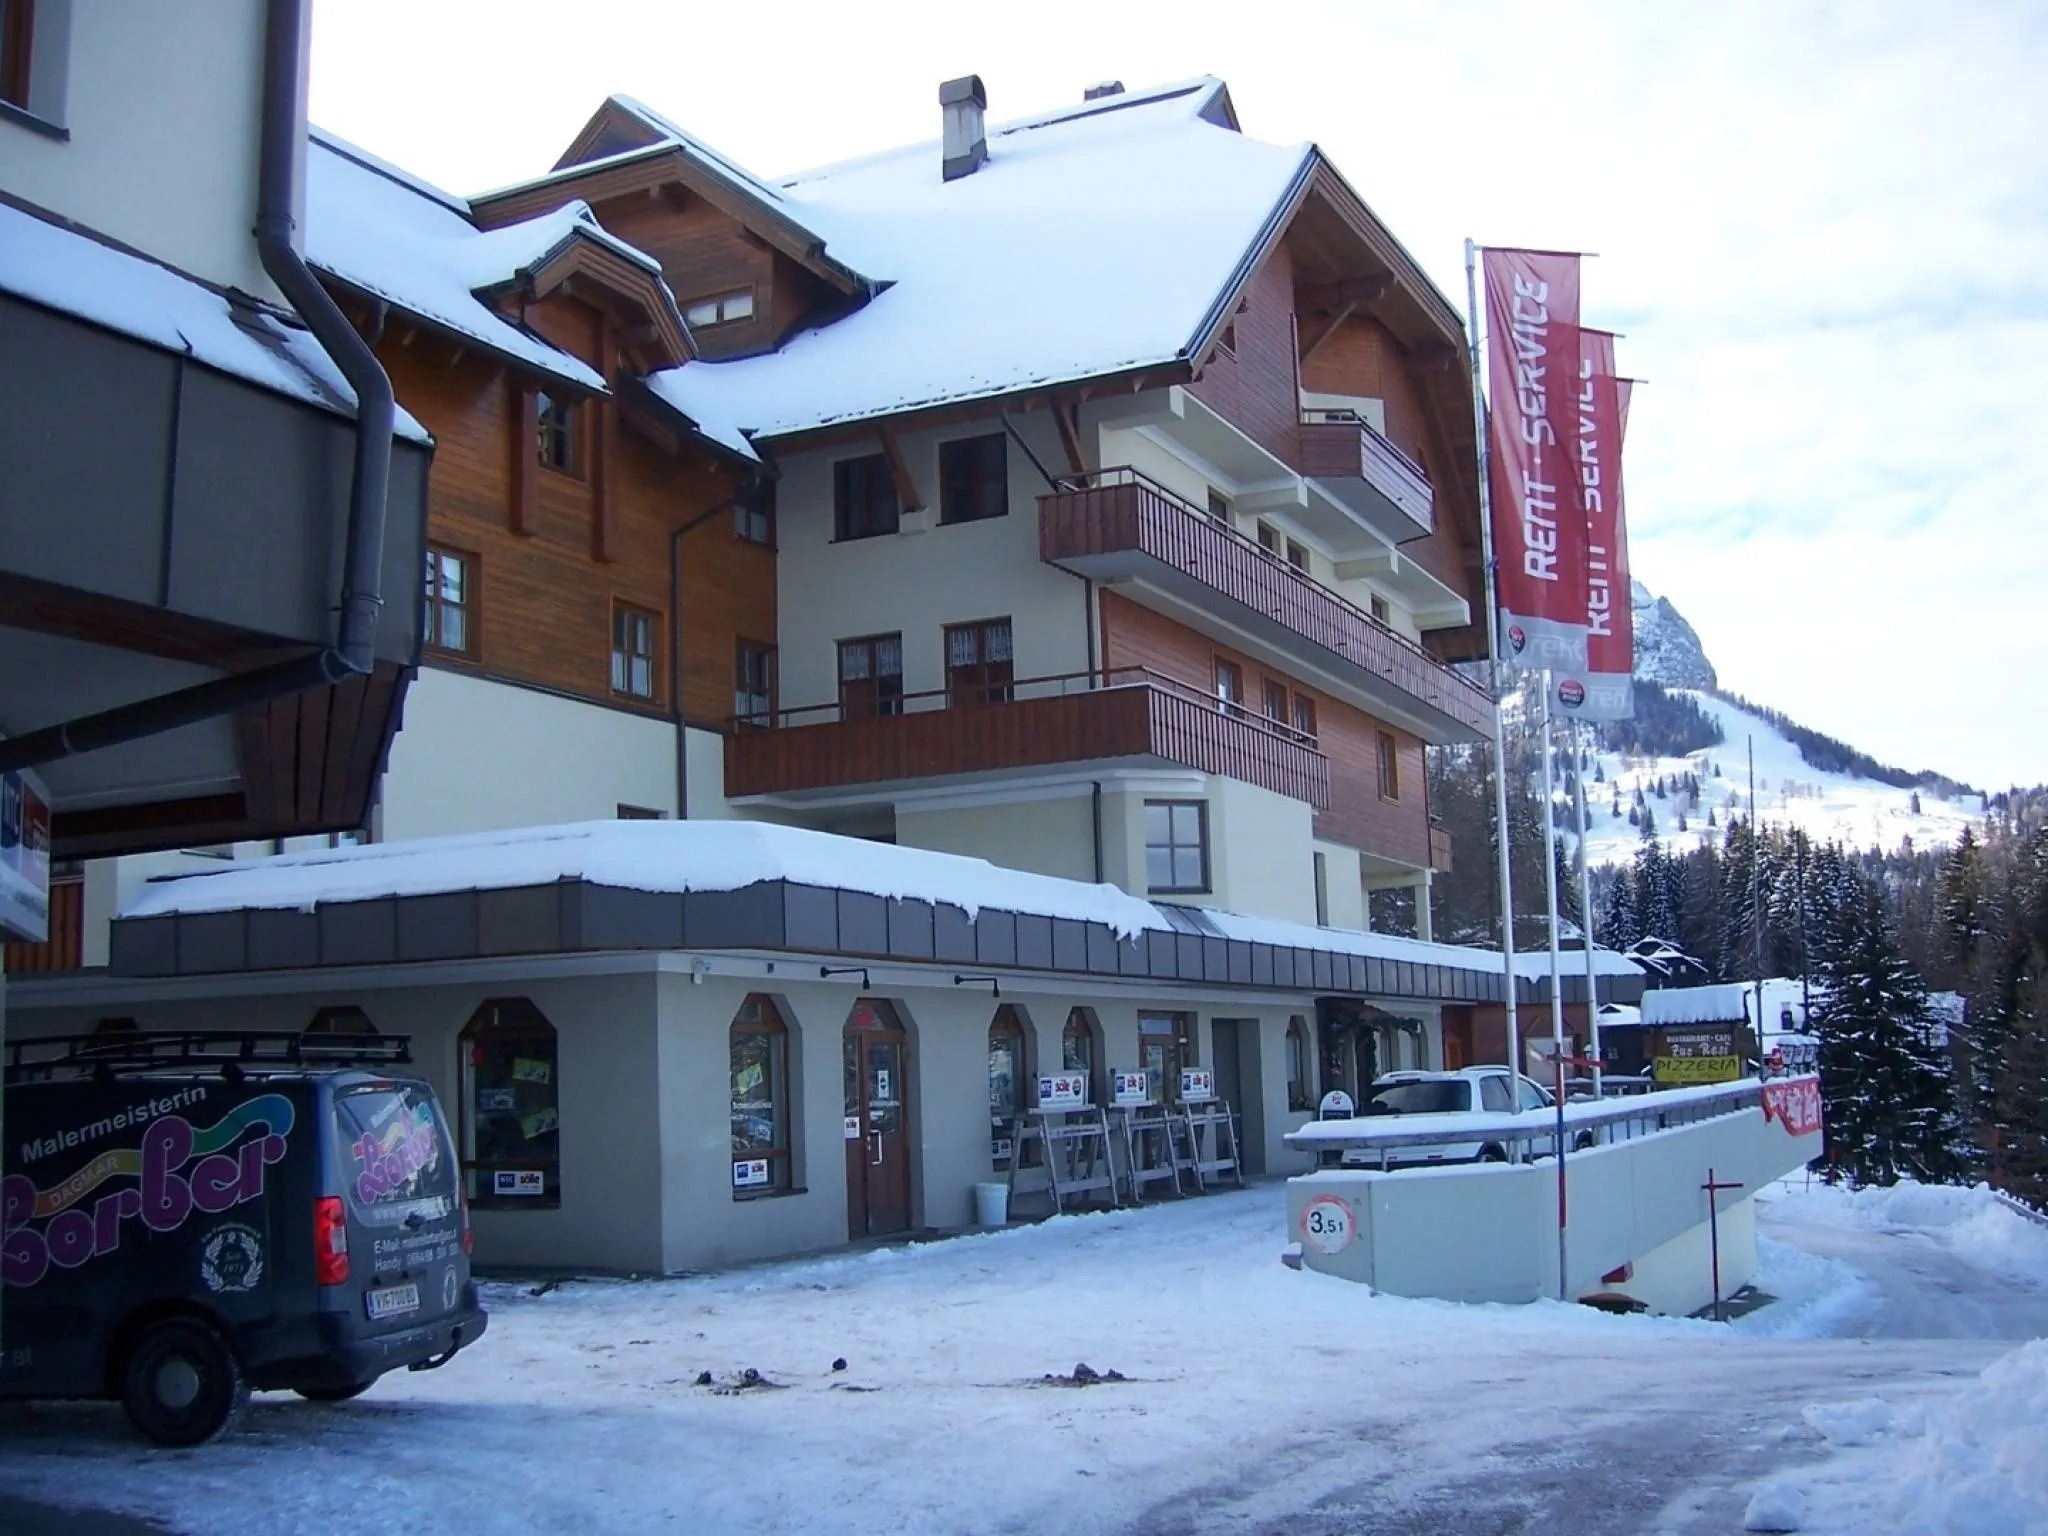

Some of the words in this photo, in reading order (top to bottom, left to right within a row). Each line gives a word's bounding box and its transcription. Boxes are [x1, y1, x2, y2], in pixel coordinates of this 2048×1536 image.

[1512, 273, 1556, 447] SERVICE
[1522, 471, 1559, 582] RENT
[1655, 1058, 1737, 1073] PIZZERIA
[21, 1086, 207, 1164] Malermeisterin
[50, 1156, 119, 1207] DAGMAR
[375, 1255, 402, 1272] Handy
